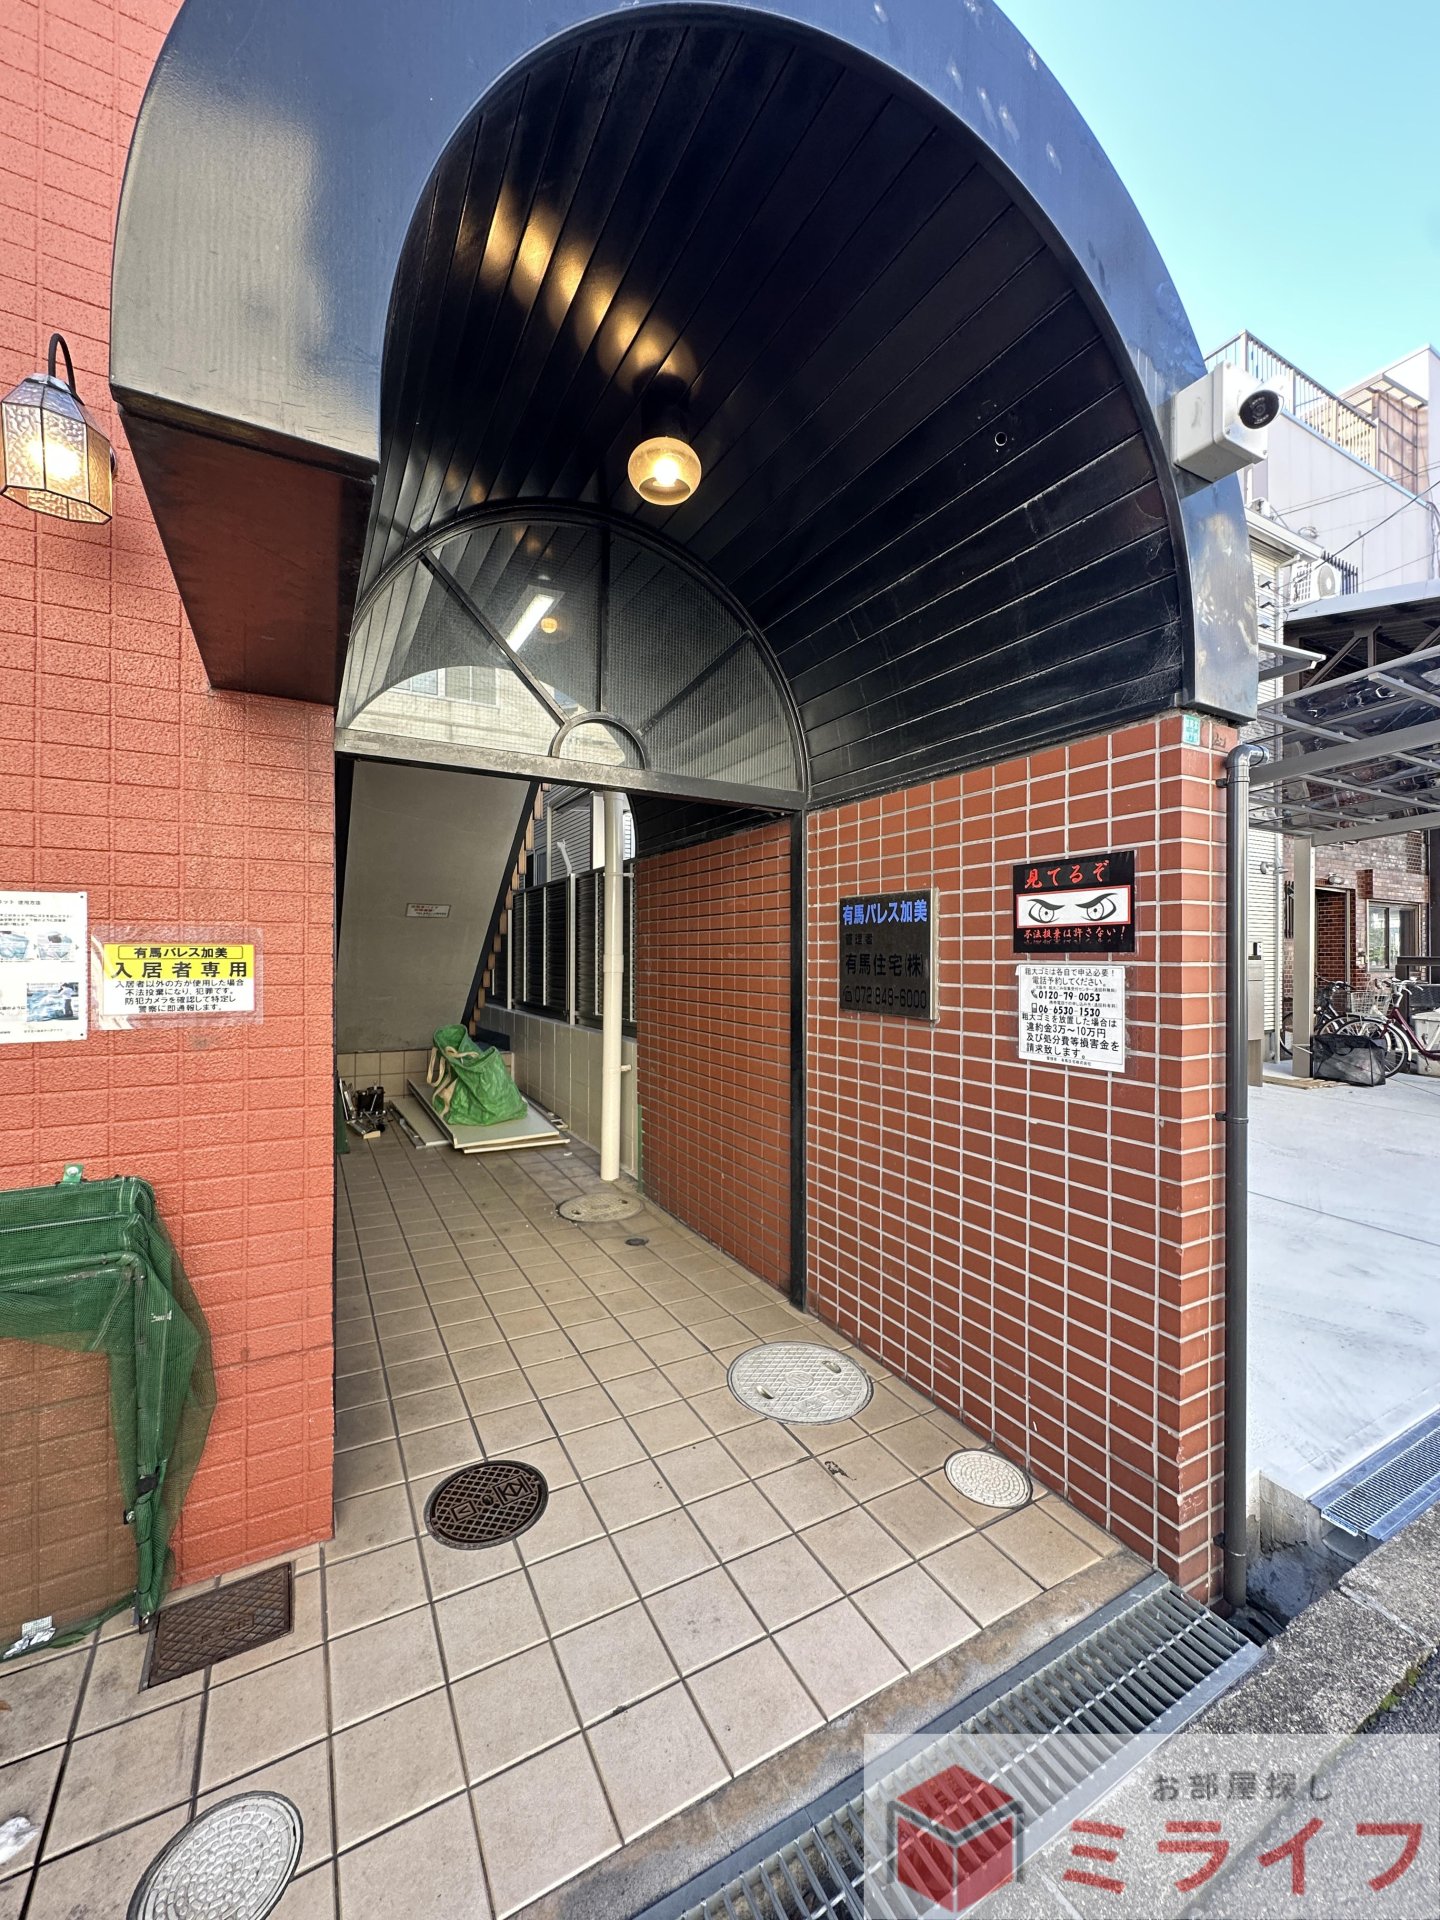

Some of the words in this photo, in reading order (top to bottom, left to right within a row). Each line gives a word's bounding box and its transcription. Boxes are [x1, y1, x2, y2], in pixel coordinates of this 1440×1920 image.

[1024, 860, 1109, 889] 見てるぞ
[843, 899, 927, 926] 有馬パレス加美
[111, 961, 248, 979] 入居者専用
[116, 979, 244, 989] 入居者以外の方が使用した場合
[125, 996, 236, 1005] 防犯カメラを確認して特定し
[1038, 991, 1100, 1002] 0120-79-0053
[1038, 1005, 1100, 1017] 06-6530-1530
[1022, 1012, 1117, 1028] 粗大ゴミを放置した場合は
[1027, 1033, 1119, 1052] 及び処分費等損害金を
[1026, 1043, 1085, 1060] 請求致します。
